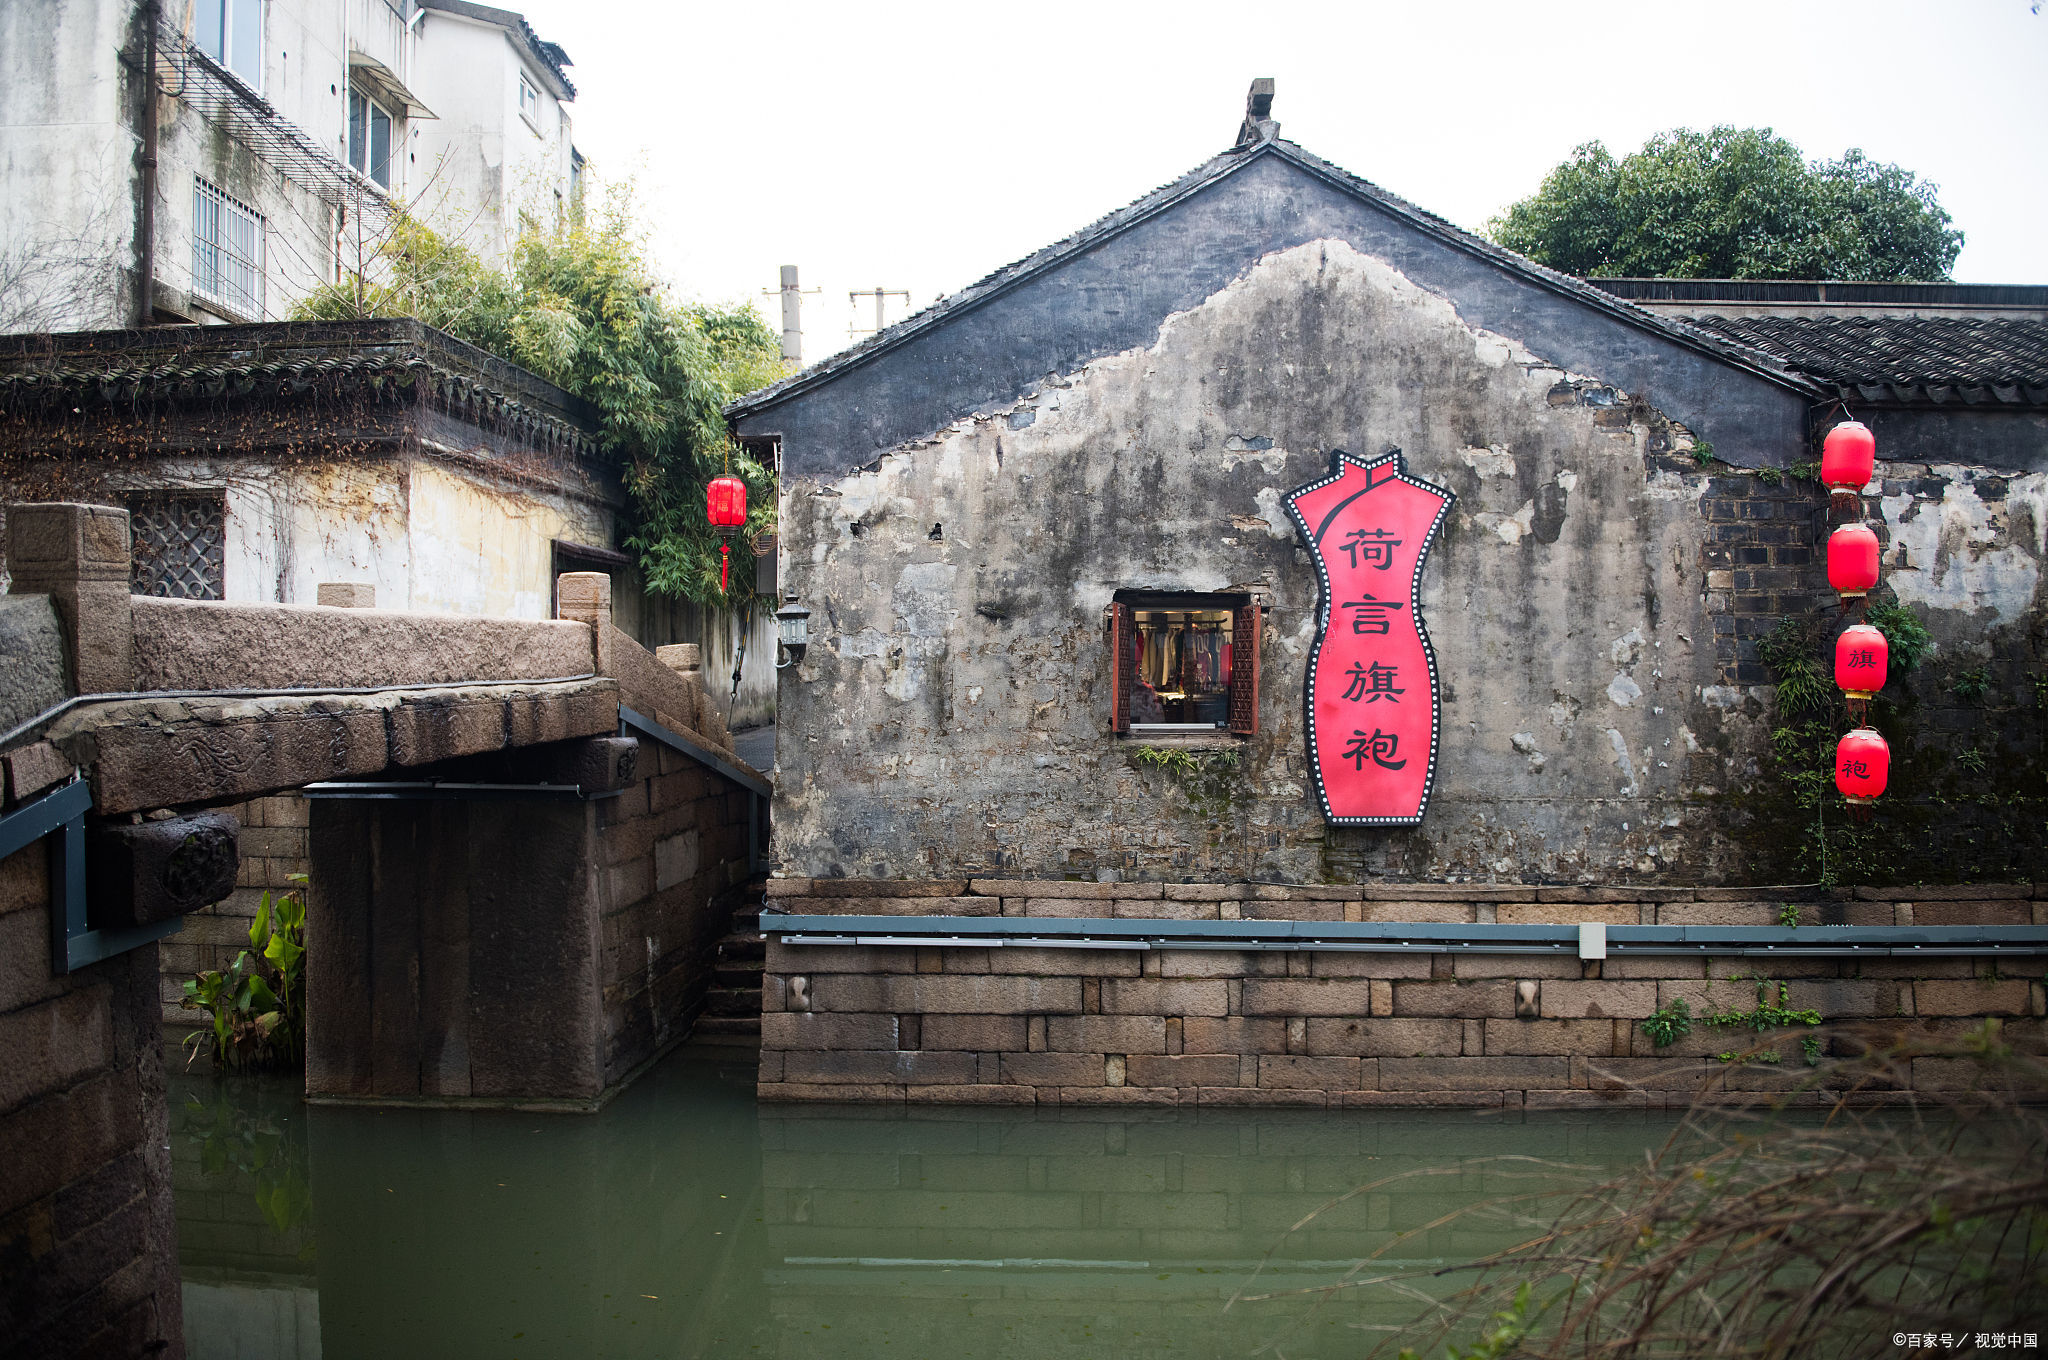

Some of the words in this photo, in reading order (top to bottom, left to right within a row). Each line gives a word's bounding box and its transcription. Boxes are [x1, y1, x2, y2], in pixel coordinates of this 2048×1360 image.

[1338, 528, 1407, 771] 荷言旗袍
[1848, 650, 1877, 669] 旗
[1841, 760, 1871, 779] 袍
